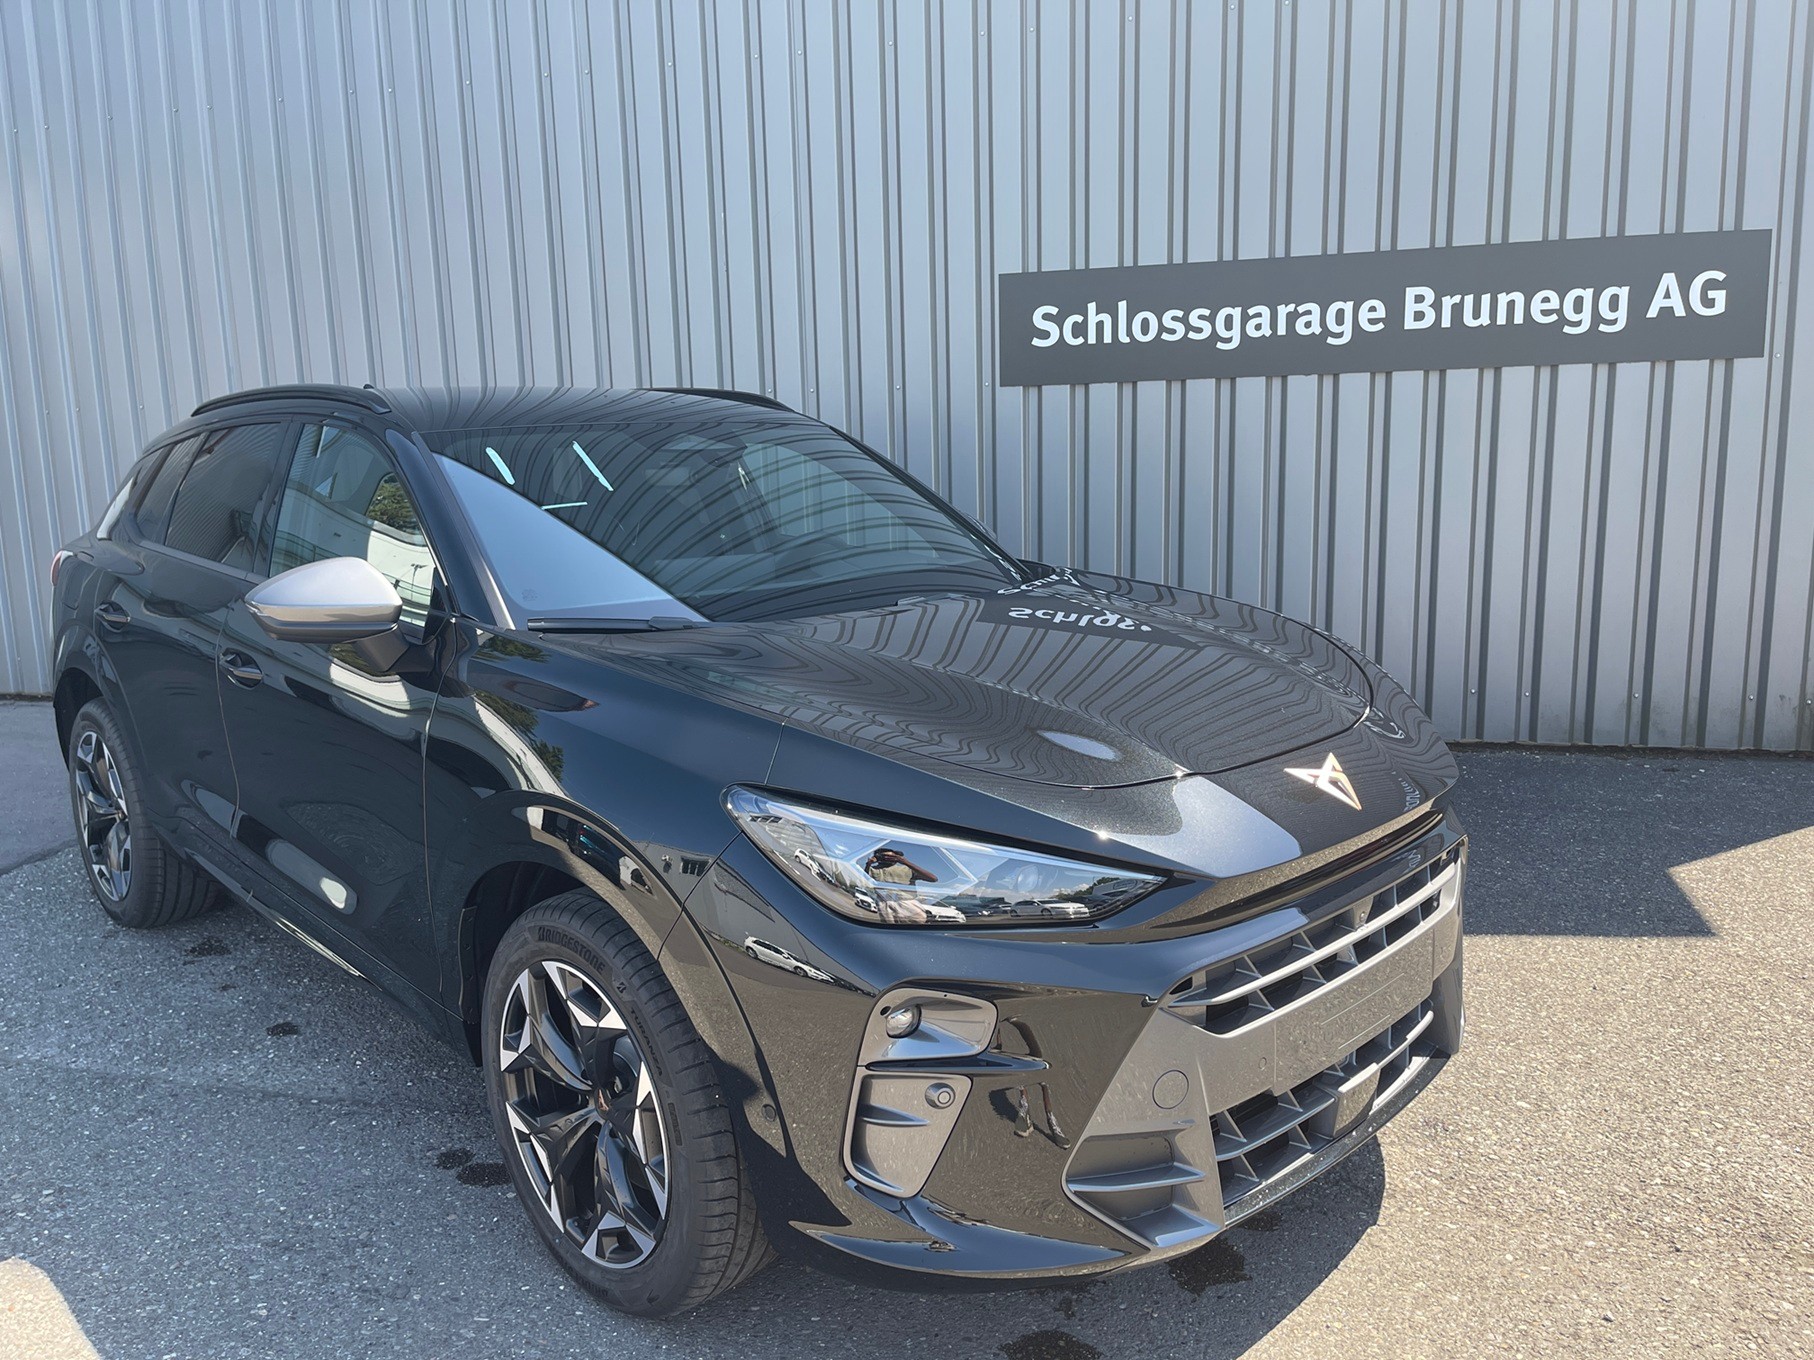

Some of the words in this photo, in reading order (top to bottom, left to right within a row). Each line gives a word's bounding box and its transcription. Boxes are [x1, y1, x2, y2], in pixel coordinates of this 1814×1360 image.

[1030, 299, 1386, 351] Schlossgarage
[1403, 285, 1631, 334] Brunegg
[1645, 270, 1727, 319] AG
[537, 926, 605, 974] BRIDGESTONE
